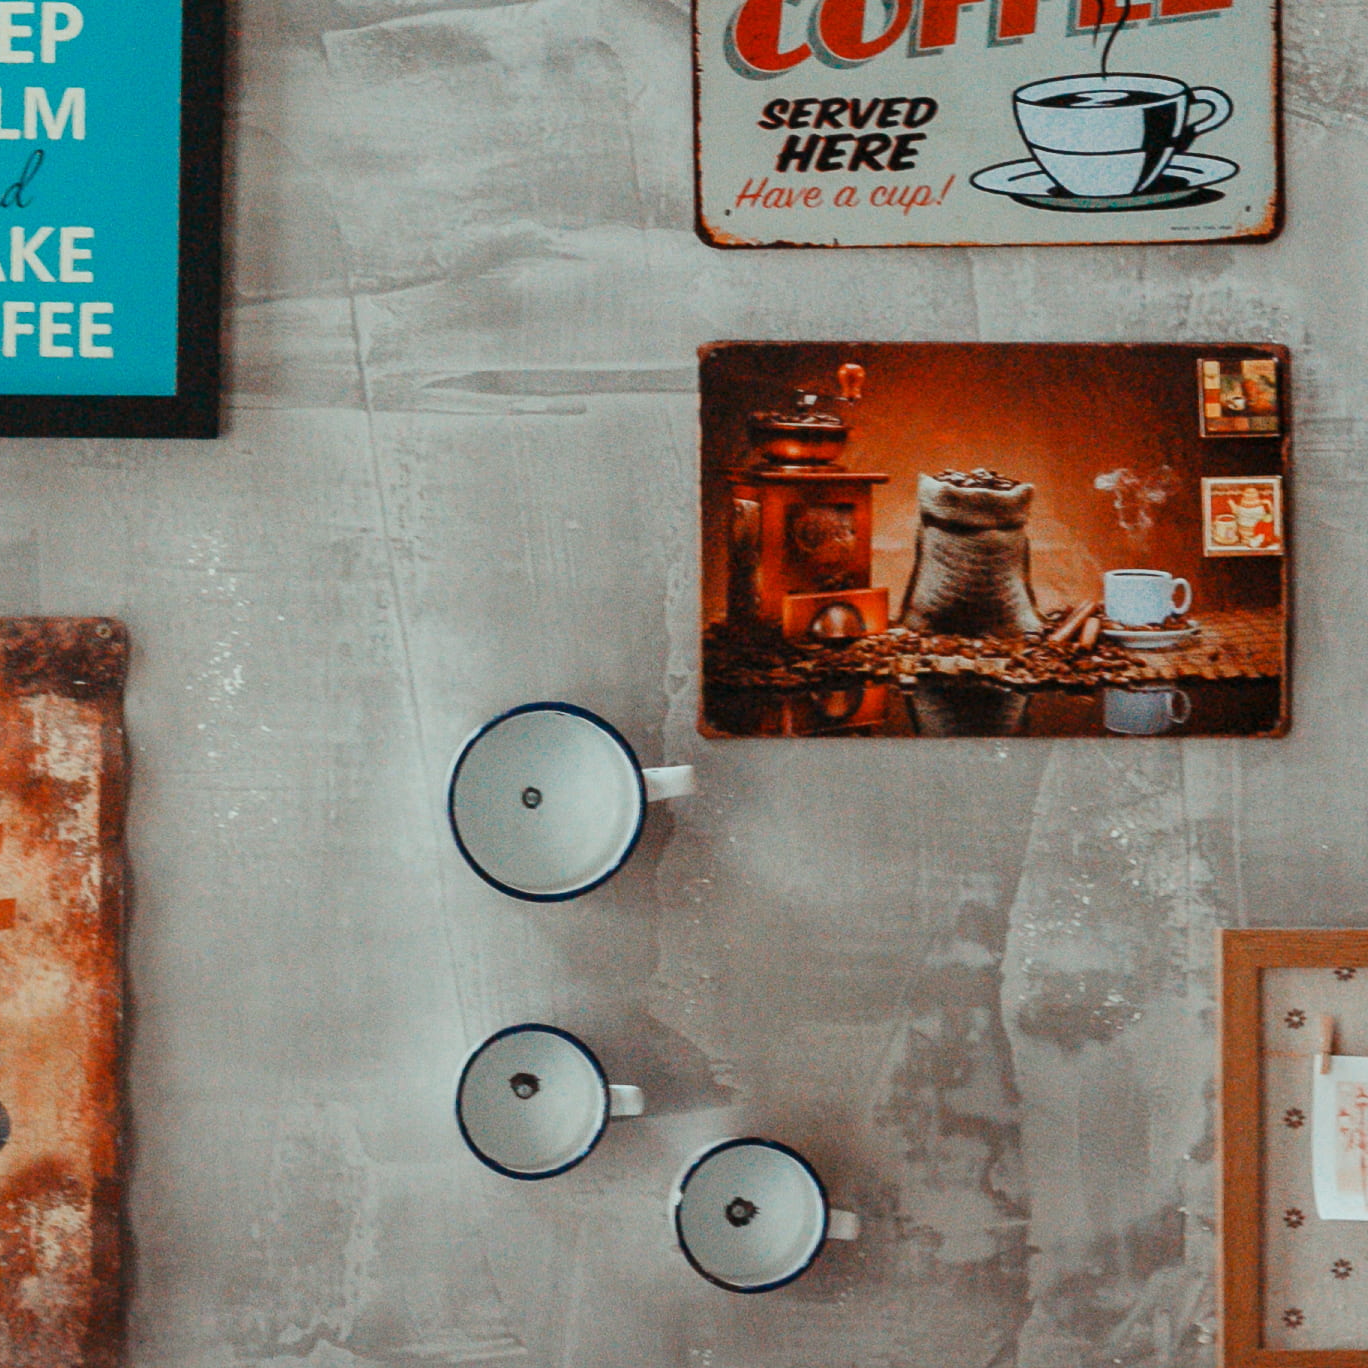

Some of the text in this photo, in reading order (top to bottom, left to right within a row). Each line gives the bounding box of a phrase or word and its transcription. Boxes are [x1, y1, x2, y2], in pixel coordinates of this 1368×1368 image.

[758, 97, 939, 131] SERVED
[776, 132, 928, 173] HERE
[734, 175, 956, 216] Have a cup!
